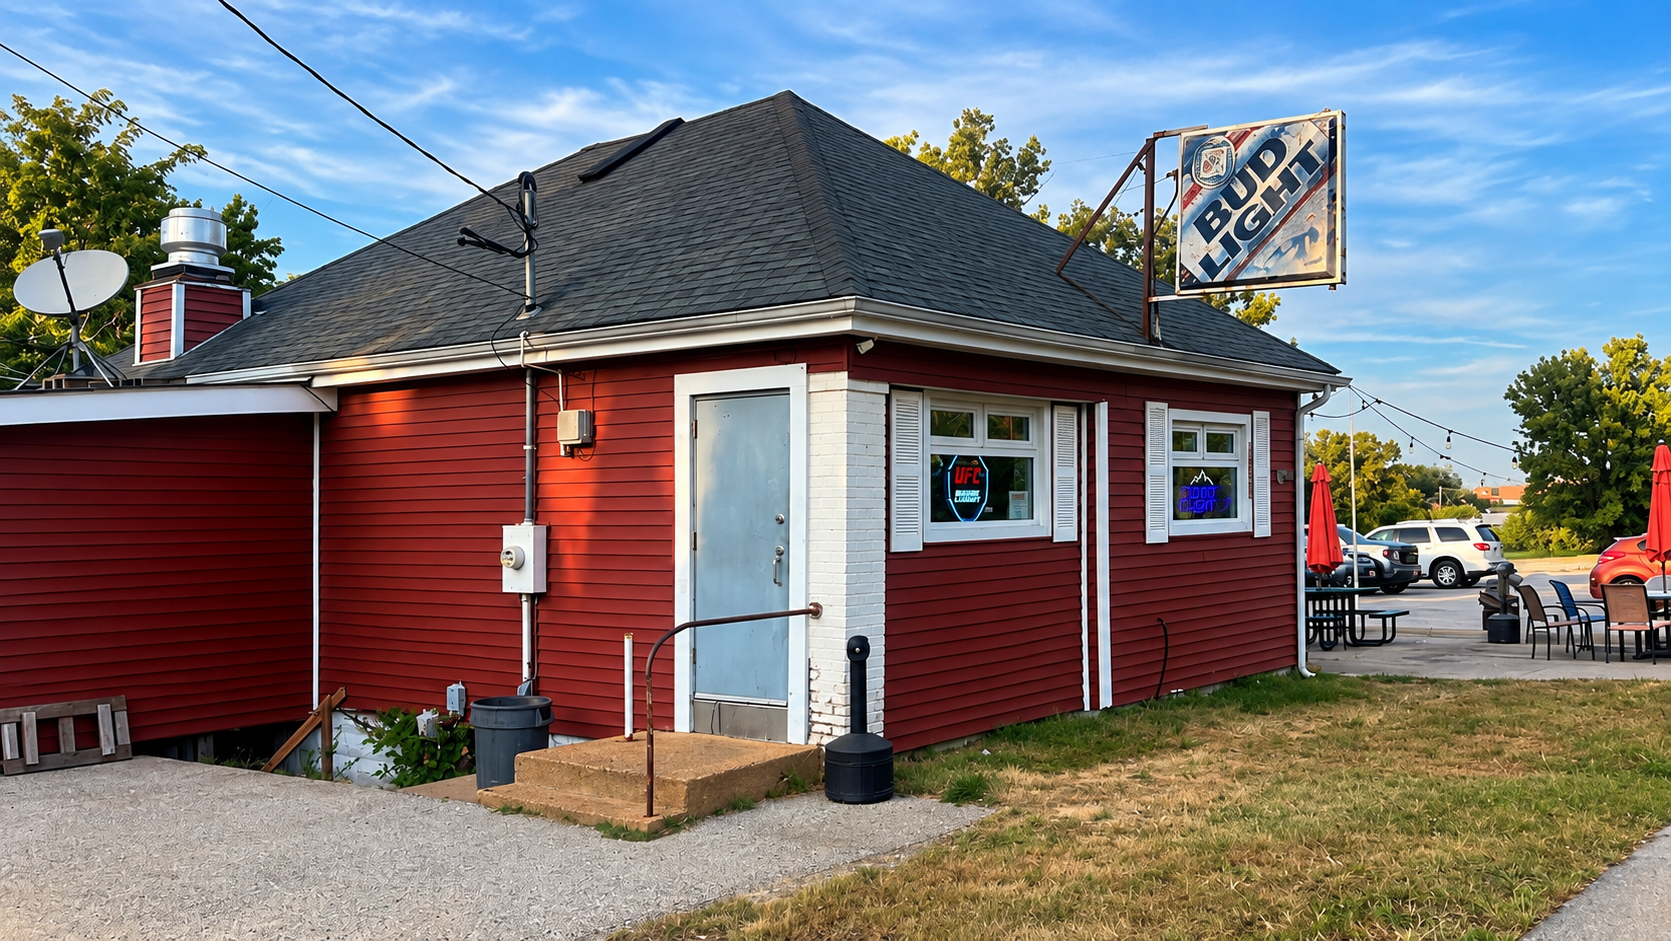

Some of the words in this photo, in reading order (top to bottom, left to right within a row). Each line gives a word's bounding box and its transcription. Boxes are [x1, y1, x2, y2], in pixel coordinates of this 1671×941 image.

[1193, 138, 1287, 244] BUD
[1198, 139, 1322, 281] LIGHT
[954, 466, 981, 485] UFC
